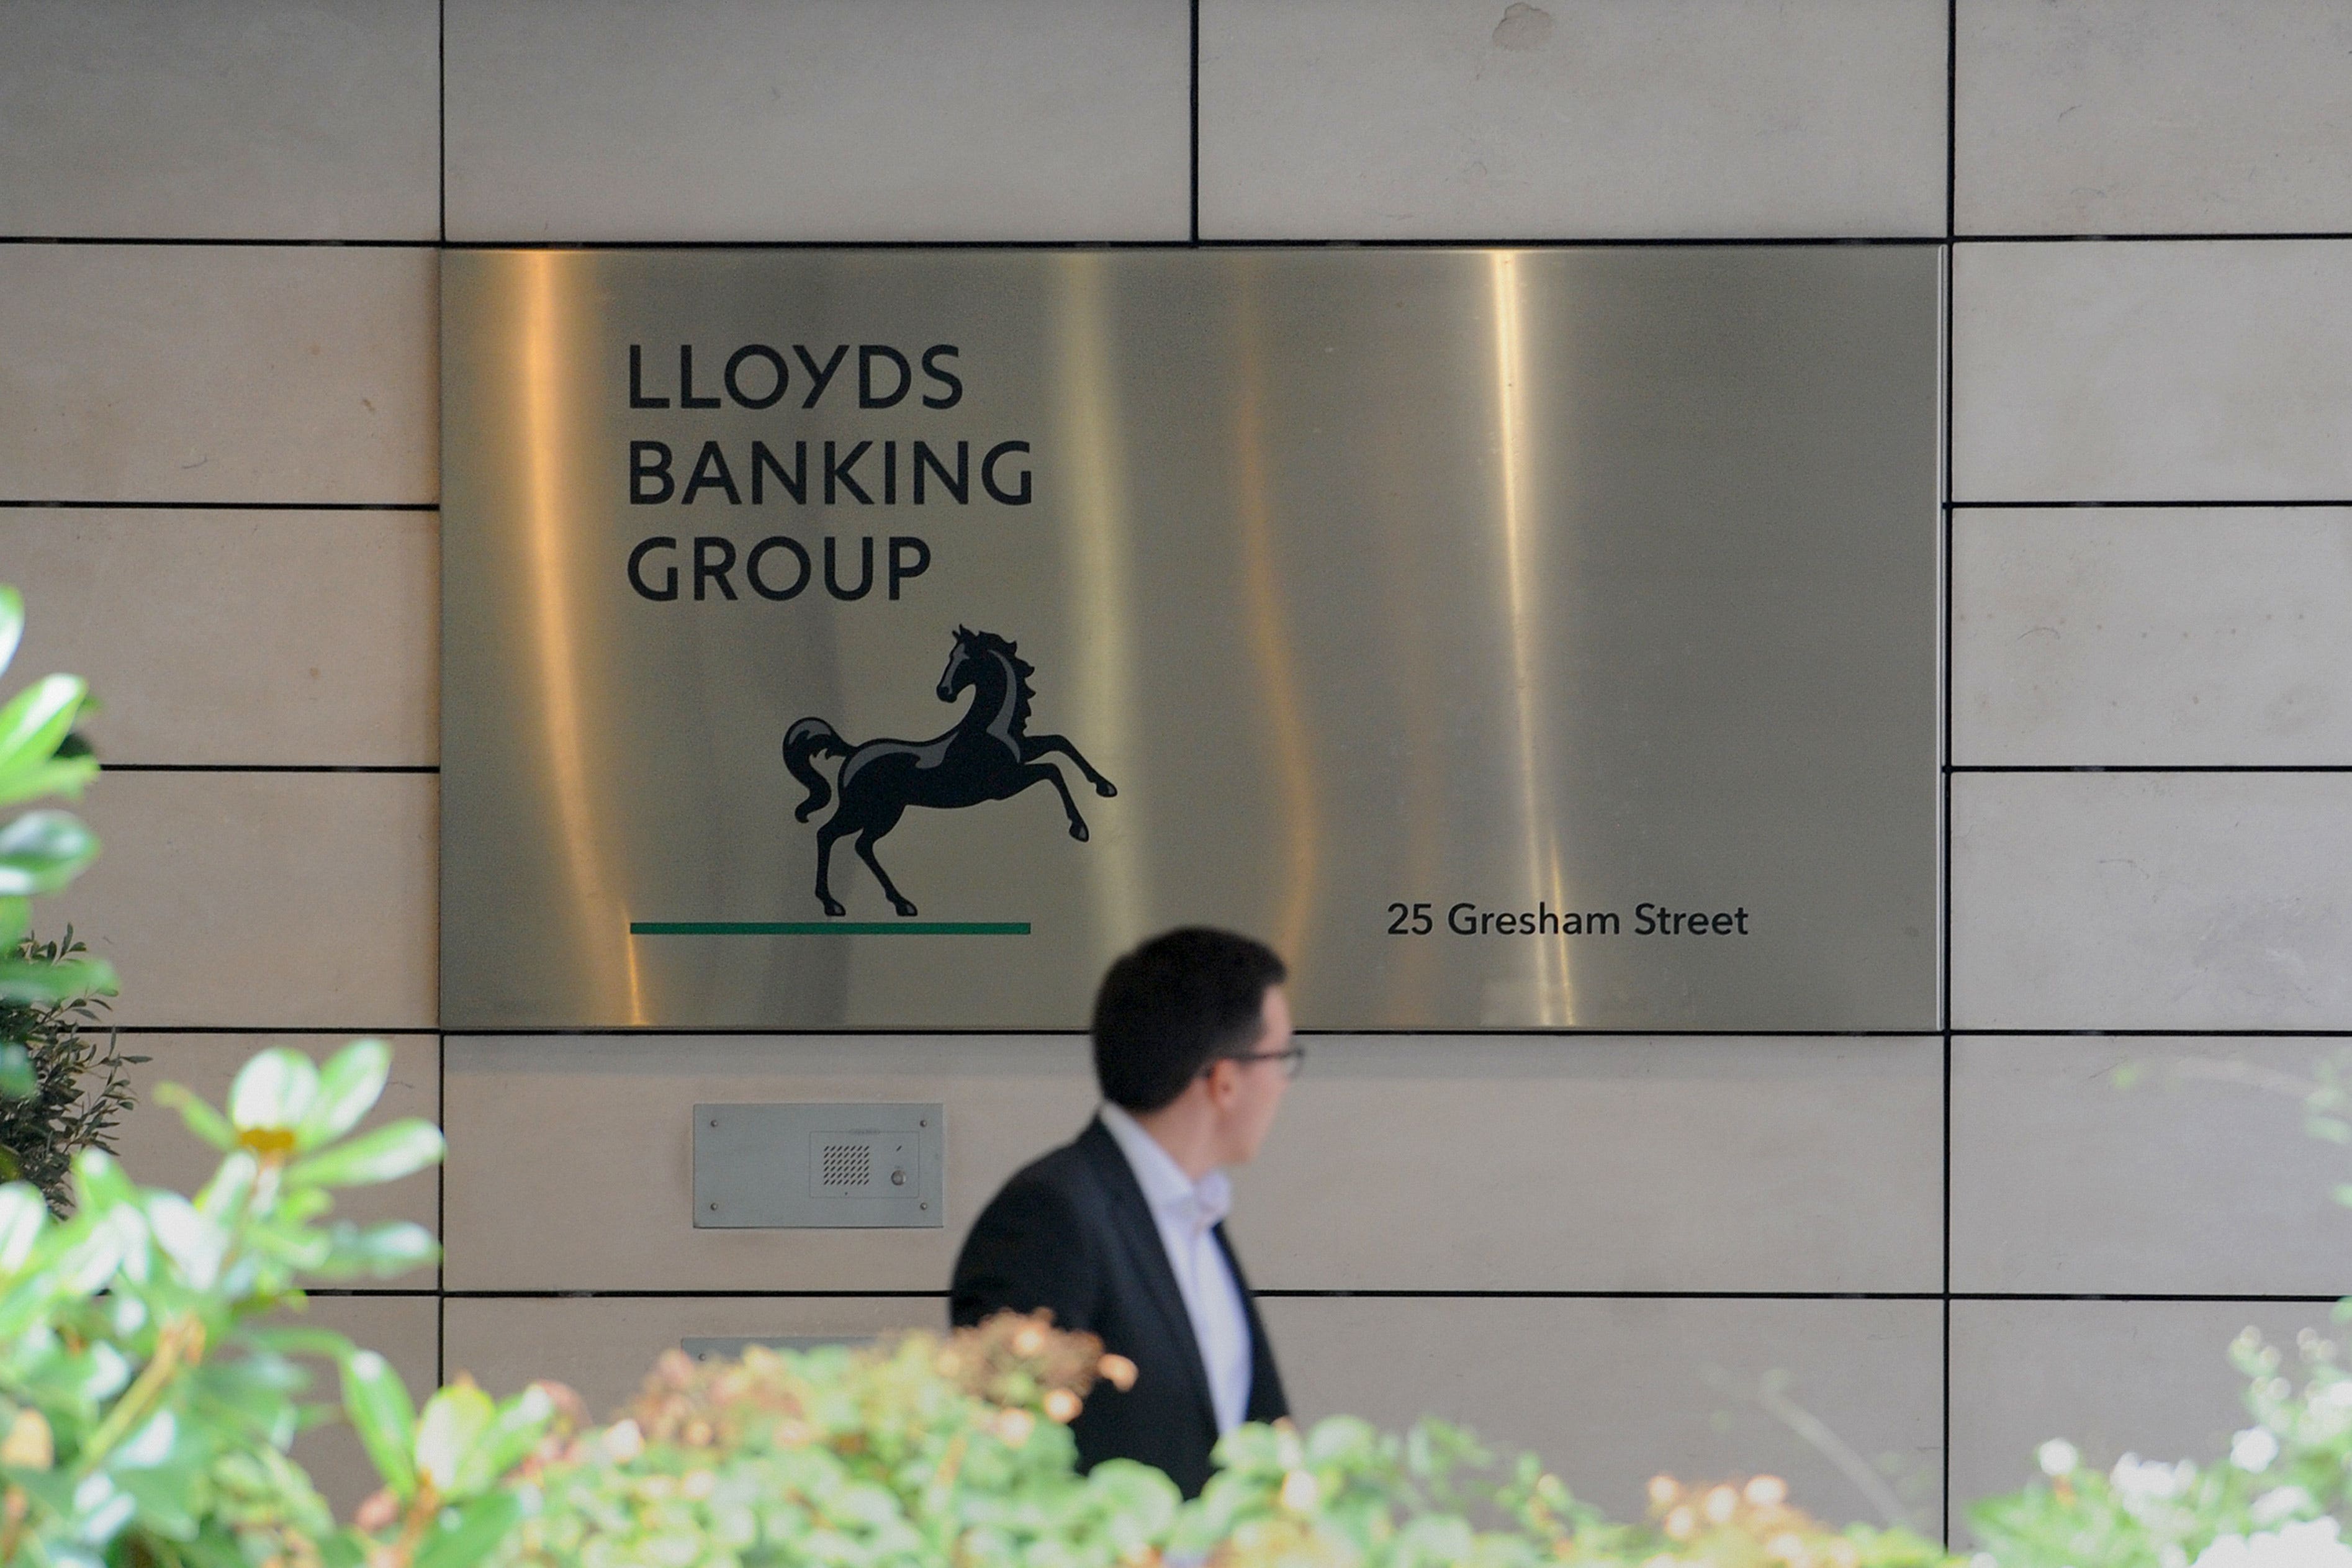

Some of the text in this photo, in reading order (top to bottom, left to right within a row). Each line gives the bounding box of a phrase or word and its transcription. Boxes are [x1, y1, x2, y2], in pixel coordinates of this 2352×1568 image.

[629, 344, 963, 410] LLOYDS
[629, 440, 1032, 506] BANKING
[627, 536, 931, 602] GROUP
[1387, 902, 1749, 935] 25 Gresham Street
